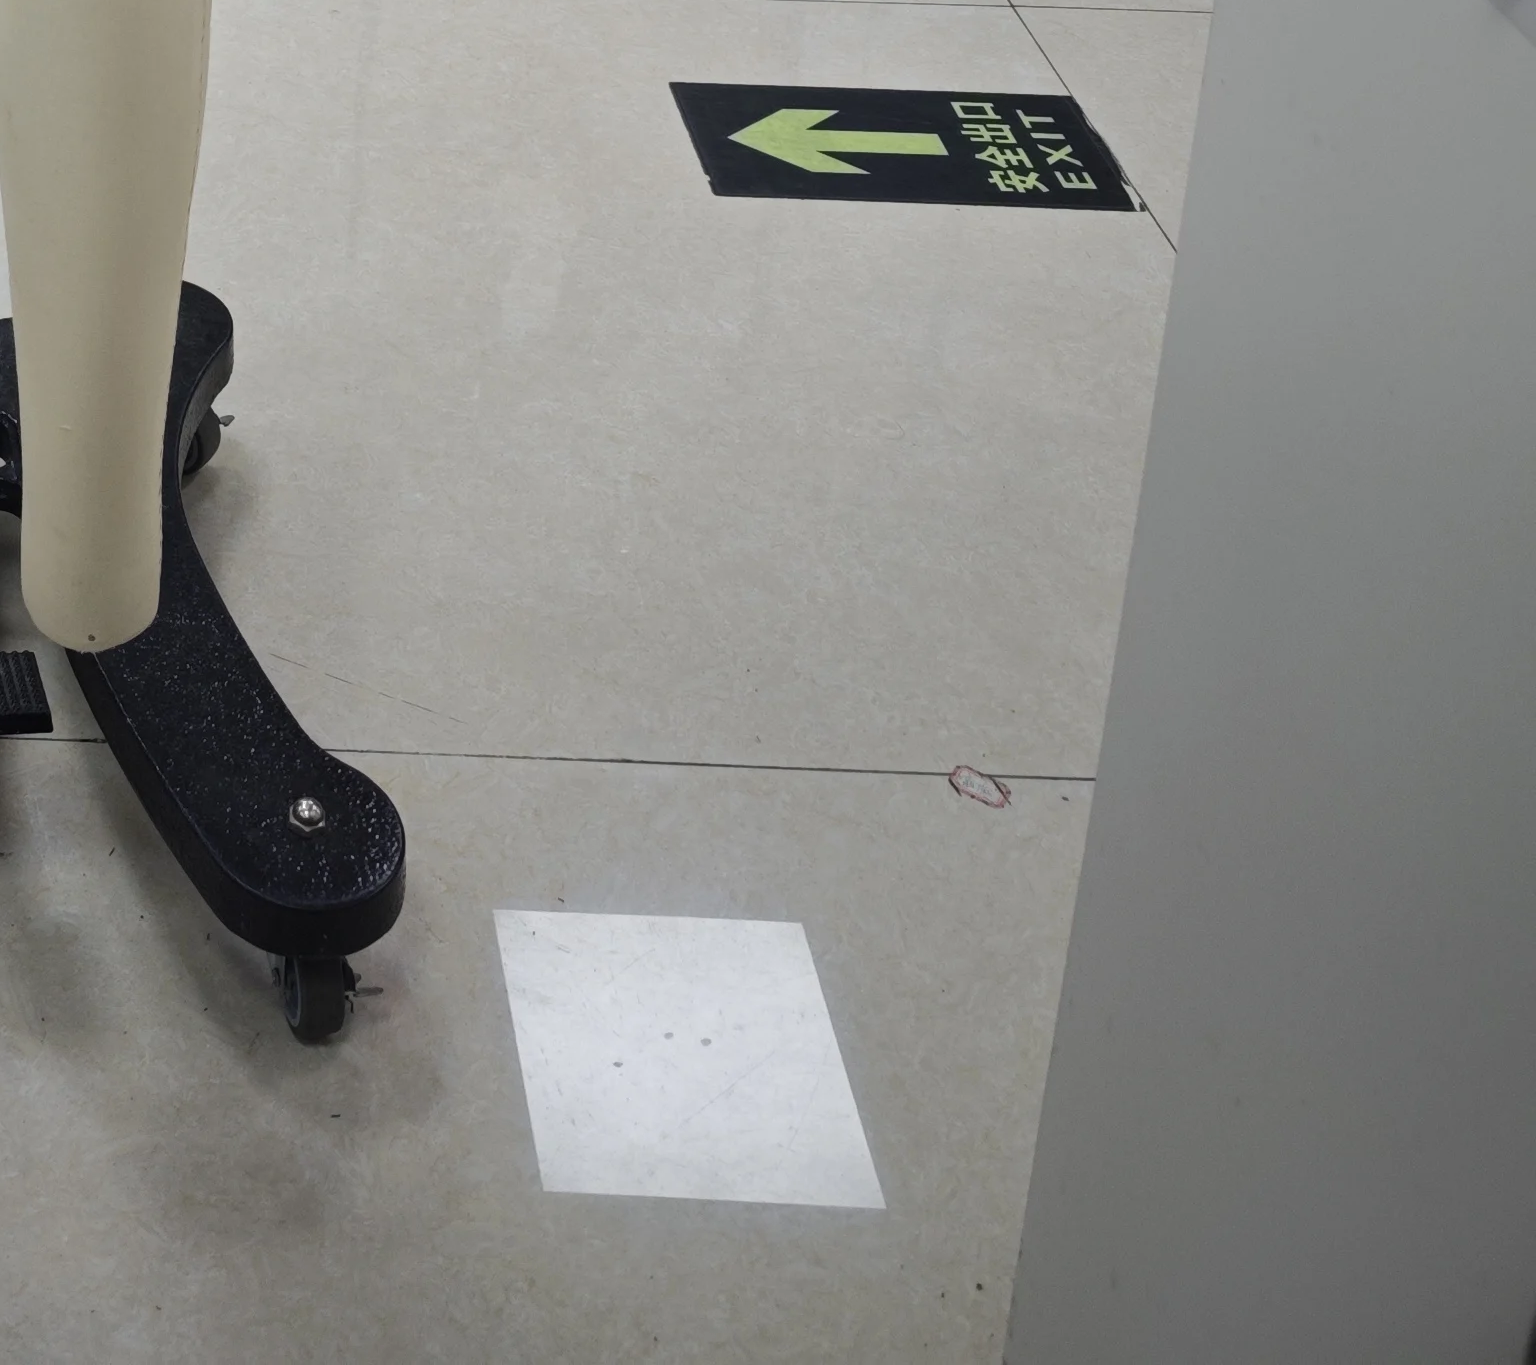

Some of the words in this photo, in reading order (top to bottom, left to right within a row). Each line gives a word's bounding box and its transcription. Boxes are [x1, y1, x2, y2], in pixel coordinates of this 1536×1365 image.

[951, 101, 1050, 193] 安全出口
[1015, 109, 1098, 191] EXIT
